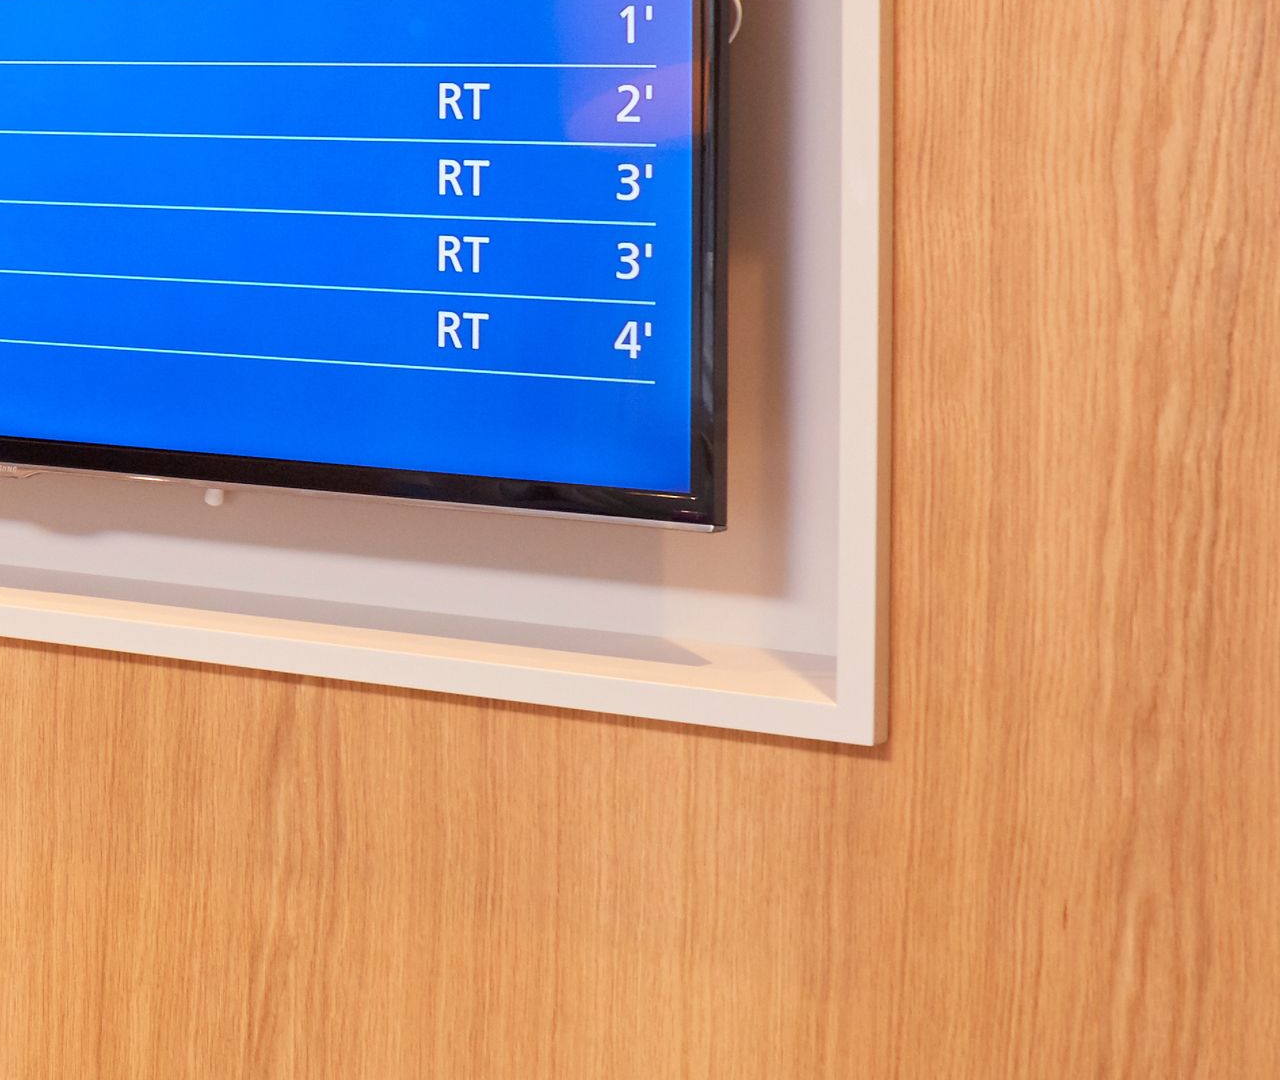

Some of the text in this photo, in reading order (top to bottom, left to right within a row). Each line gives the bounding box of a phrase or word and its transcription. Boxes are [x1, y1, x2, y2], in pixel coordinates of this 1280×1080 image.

[619, 5, 653, 44] 1'
[438, 82, 491, 120] RT
[616, 84, 653, 123] 2'
[438, 159, 490, 197] RT
[616, 163, 653, 201] 3'
[438, 235, 490, 273] RT
[615, 242, 652, 280] 3'
[437, 311, 490, 350] RT
[614, 321, 652, 359] 4'
